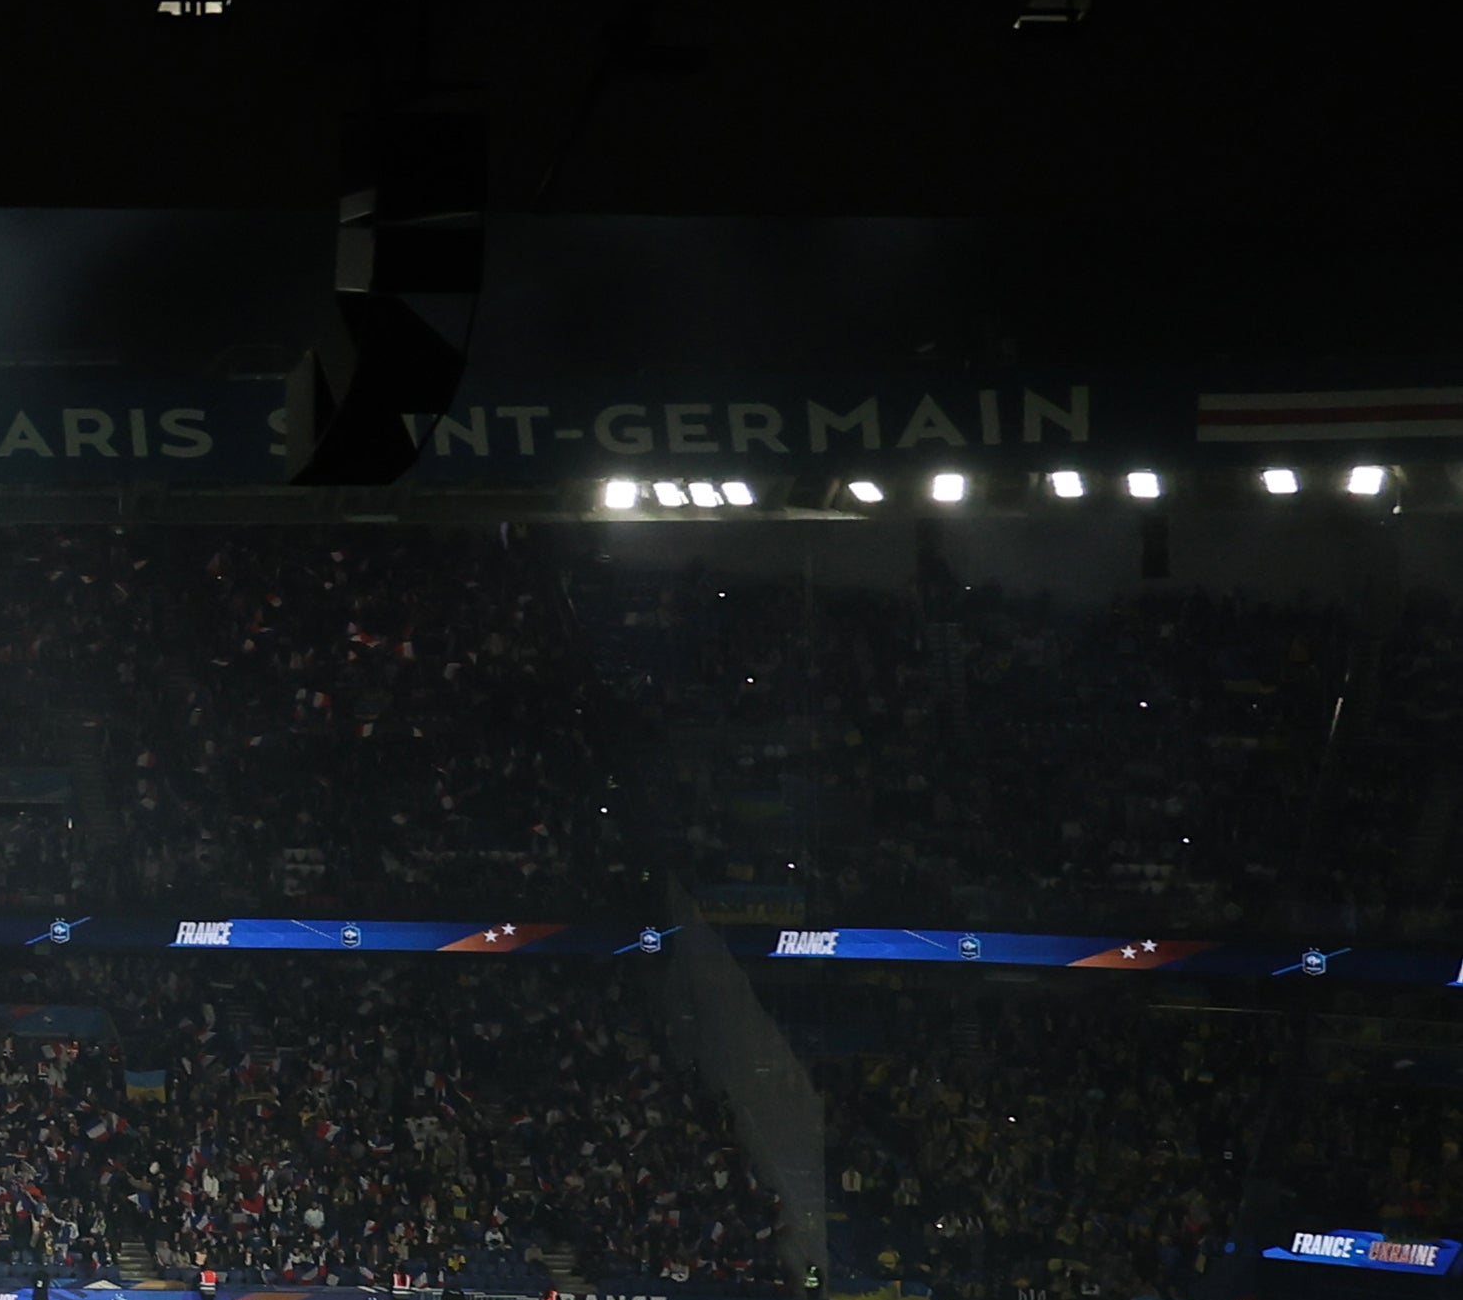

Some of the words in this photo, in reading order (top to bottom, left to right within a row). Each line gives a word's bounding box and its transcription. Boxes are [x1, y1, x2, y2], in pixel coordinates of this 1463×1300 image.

[268, 387, 1090, 457] NT-GERMAIN
[176, 921, 232, 945] FRANCE
[777, 931, 838, 955] FRANCE
[1293, 1232, 1355, 1258] FRANCE
[1369, 1241, 1438, 1266] UKRAINE
